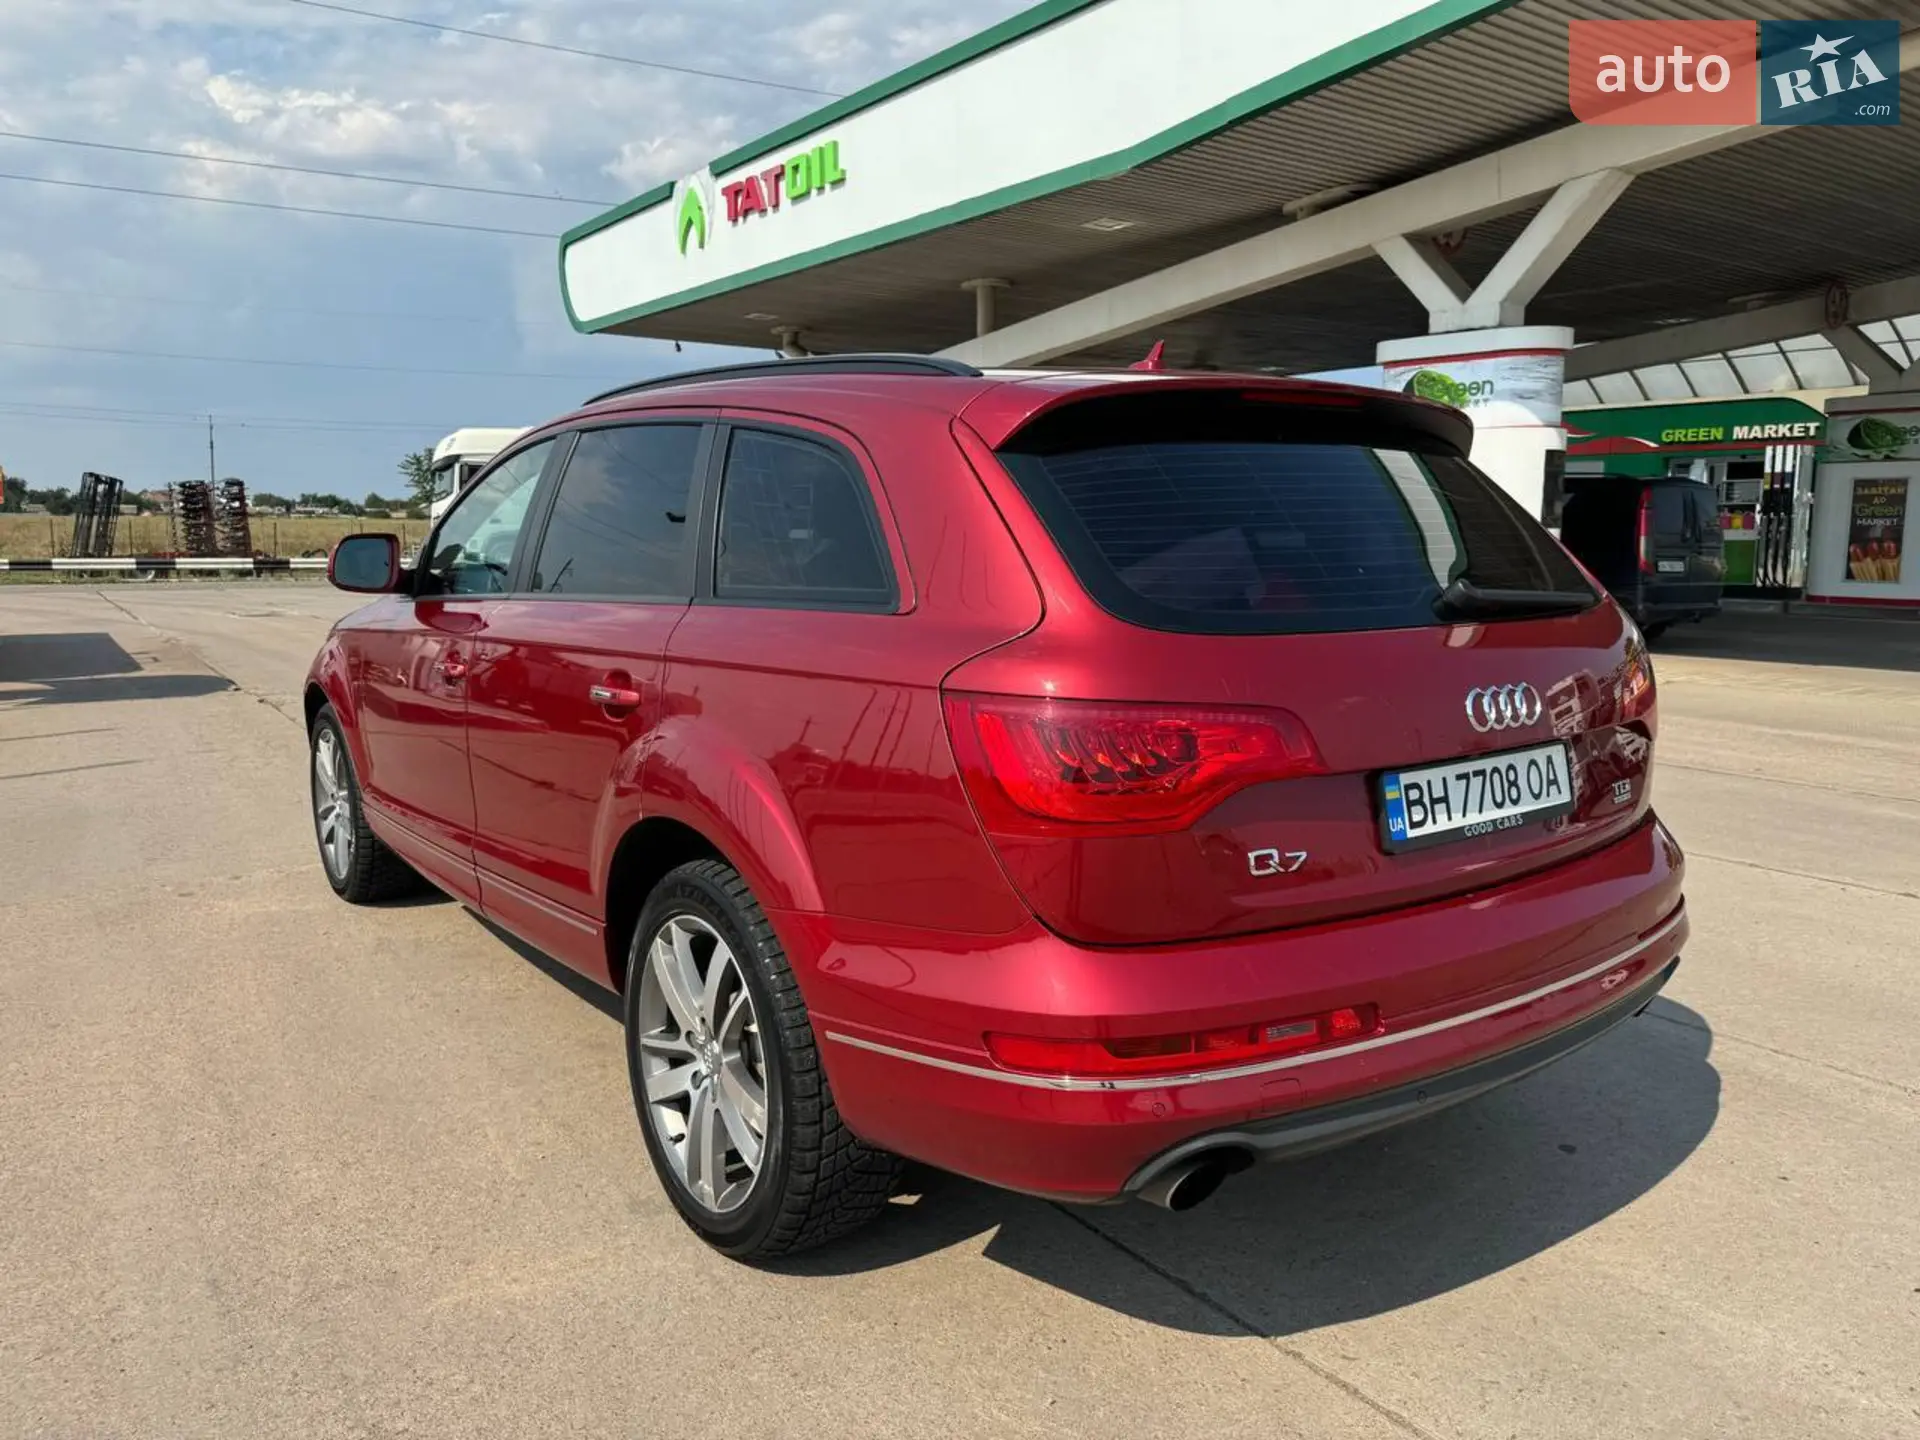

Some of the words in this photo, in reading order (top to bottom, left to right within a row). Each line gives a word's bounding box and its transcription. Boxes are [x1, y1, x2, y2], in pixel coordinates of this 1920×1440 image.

[721, 140, 847, 222] TATOIL
[1661, 427, 1724, 442] GREEN
[1732, 422, 1820, 440] MARKET
[1403, 776, 1453, 830] BH
[1455, 763, 1522, 818] 7708
[1527, 754, 1562, 801] OA
[1388, 817, 1405, 832] UA
[1464, 822, 1494, 837] GOOD
[1496, 814, 1524, 829] CARS
[1247, 848, 1308, 876] Q7
